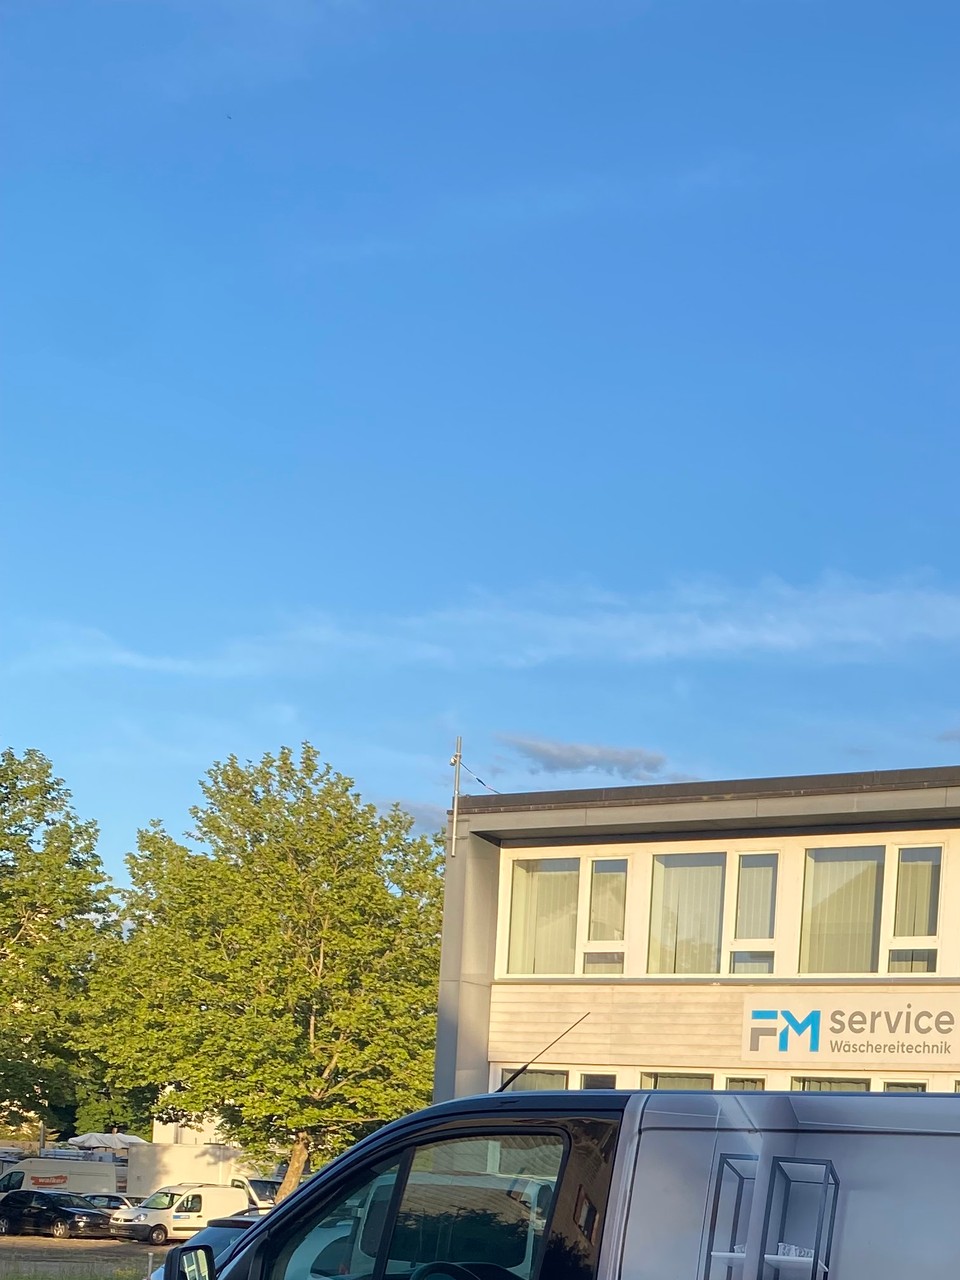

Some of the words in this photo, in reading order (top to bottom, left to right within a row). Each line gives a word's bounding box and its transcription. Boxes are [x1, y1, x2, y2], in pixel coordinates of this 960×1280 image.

[750, 1010, 821, 1052] FM
[829, 1003, 955, 1034] service
[829, 1040, 951, 1054] Wäschereitechnik
